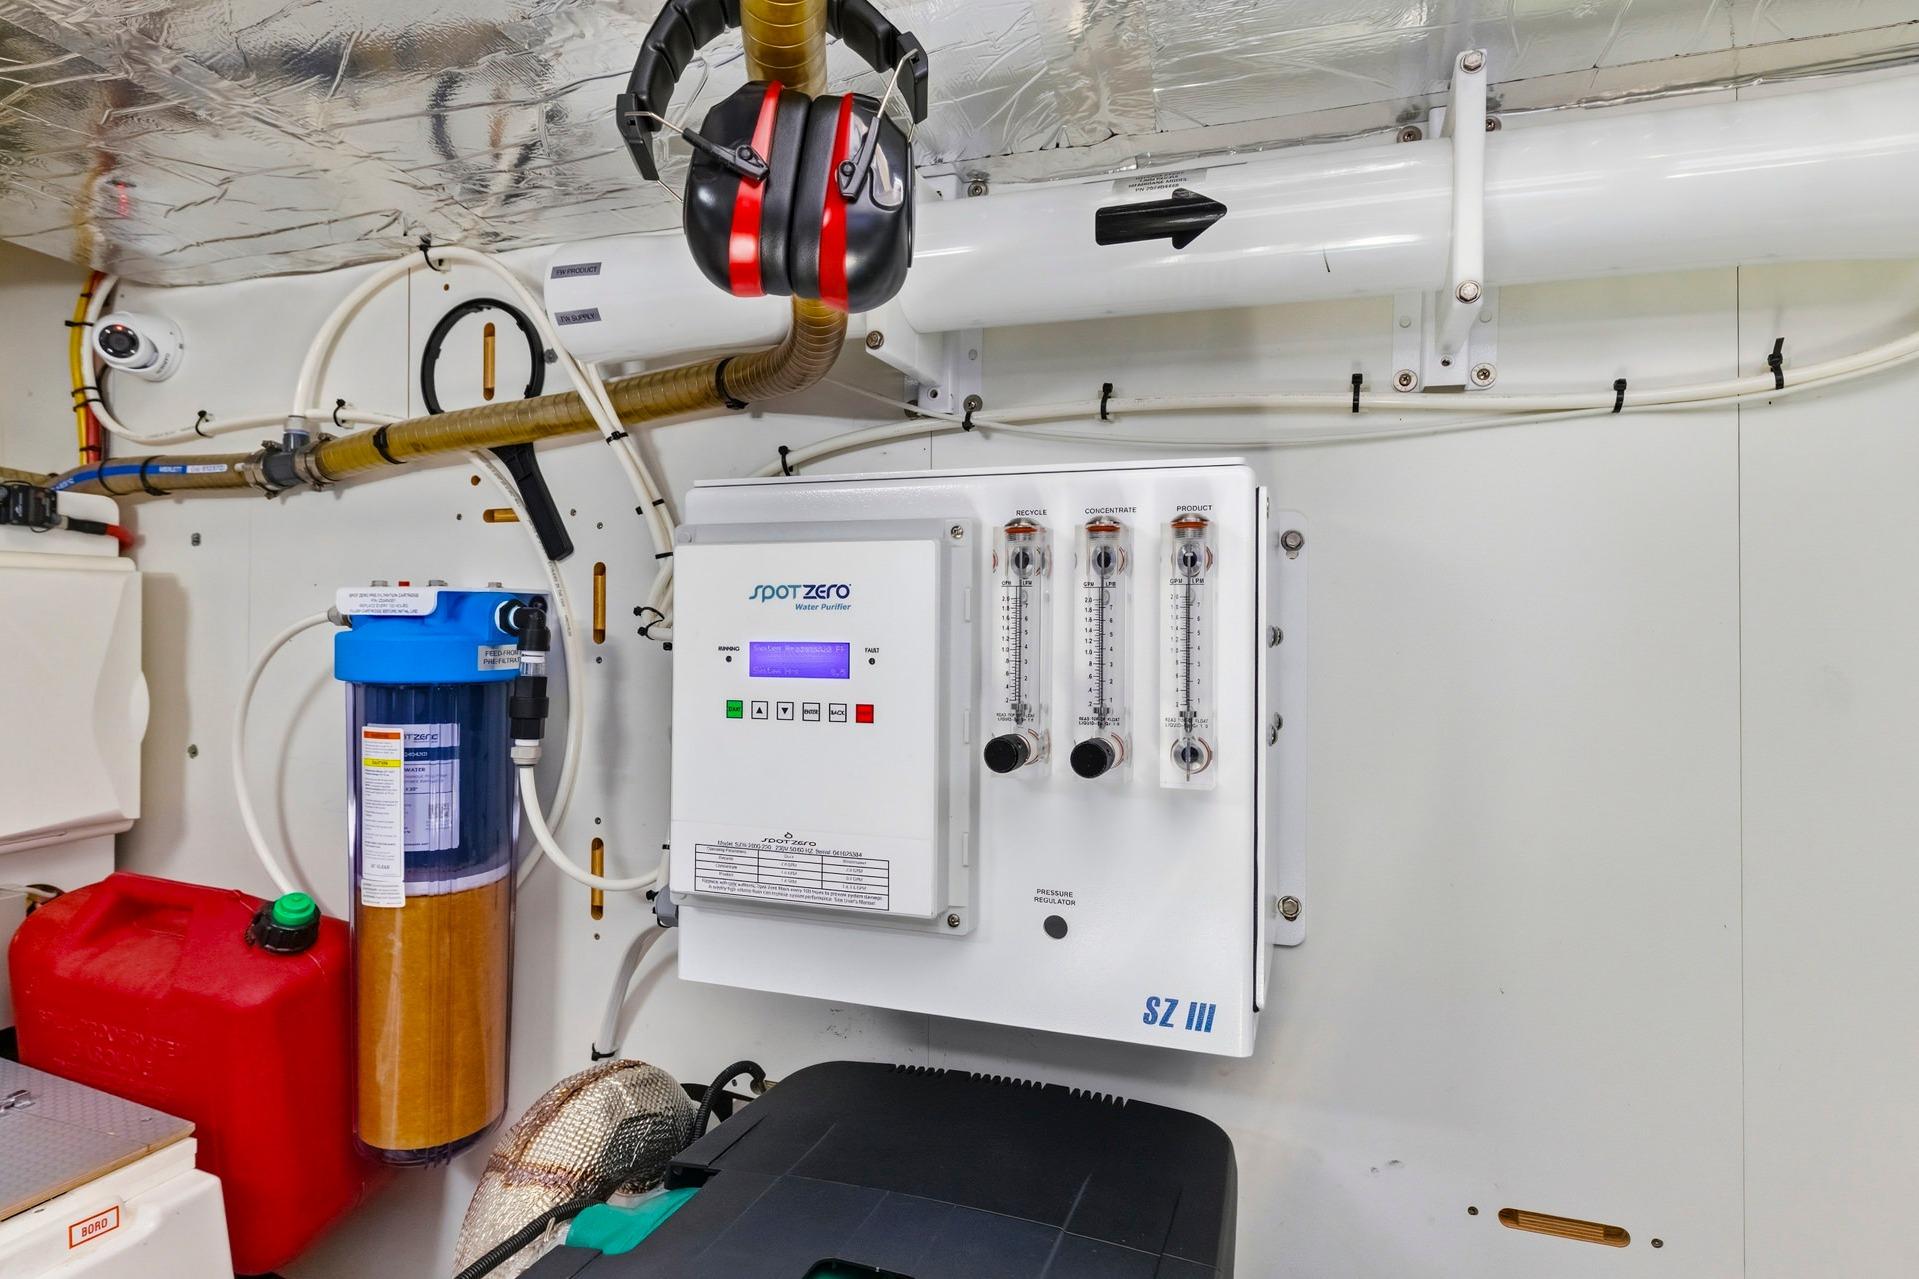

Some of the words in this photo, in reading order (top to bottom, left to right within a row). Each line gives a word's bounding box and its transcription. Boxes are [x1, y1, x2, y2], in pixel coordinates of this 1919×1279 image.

[566, 266, 598, 275] PRODUCT
[795, 602, 819, 611] Water
[820, 602, 851, 611] Purifier
[1036, 888, 1074, 898] PRESSURE
[1034, 896, 1076, 906] REGULATOR
[1142, 996, 1179, 1028] SZ
[1185, 1002, 1216, 1033] III
